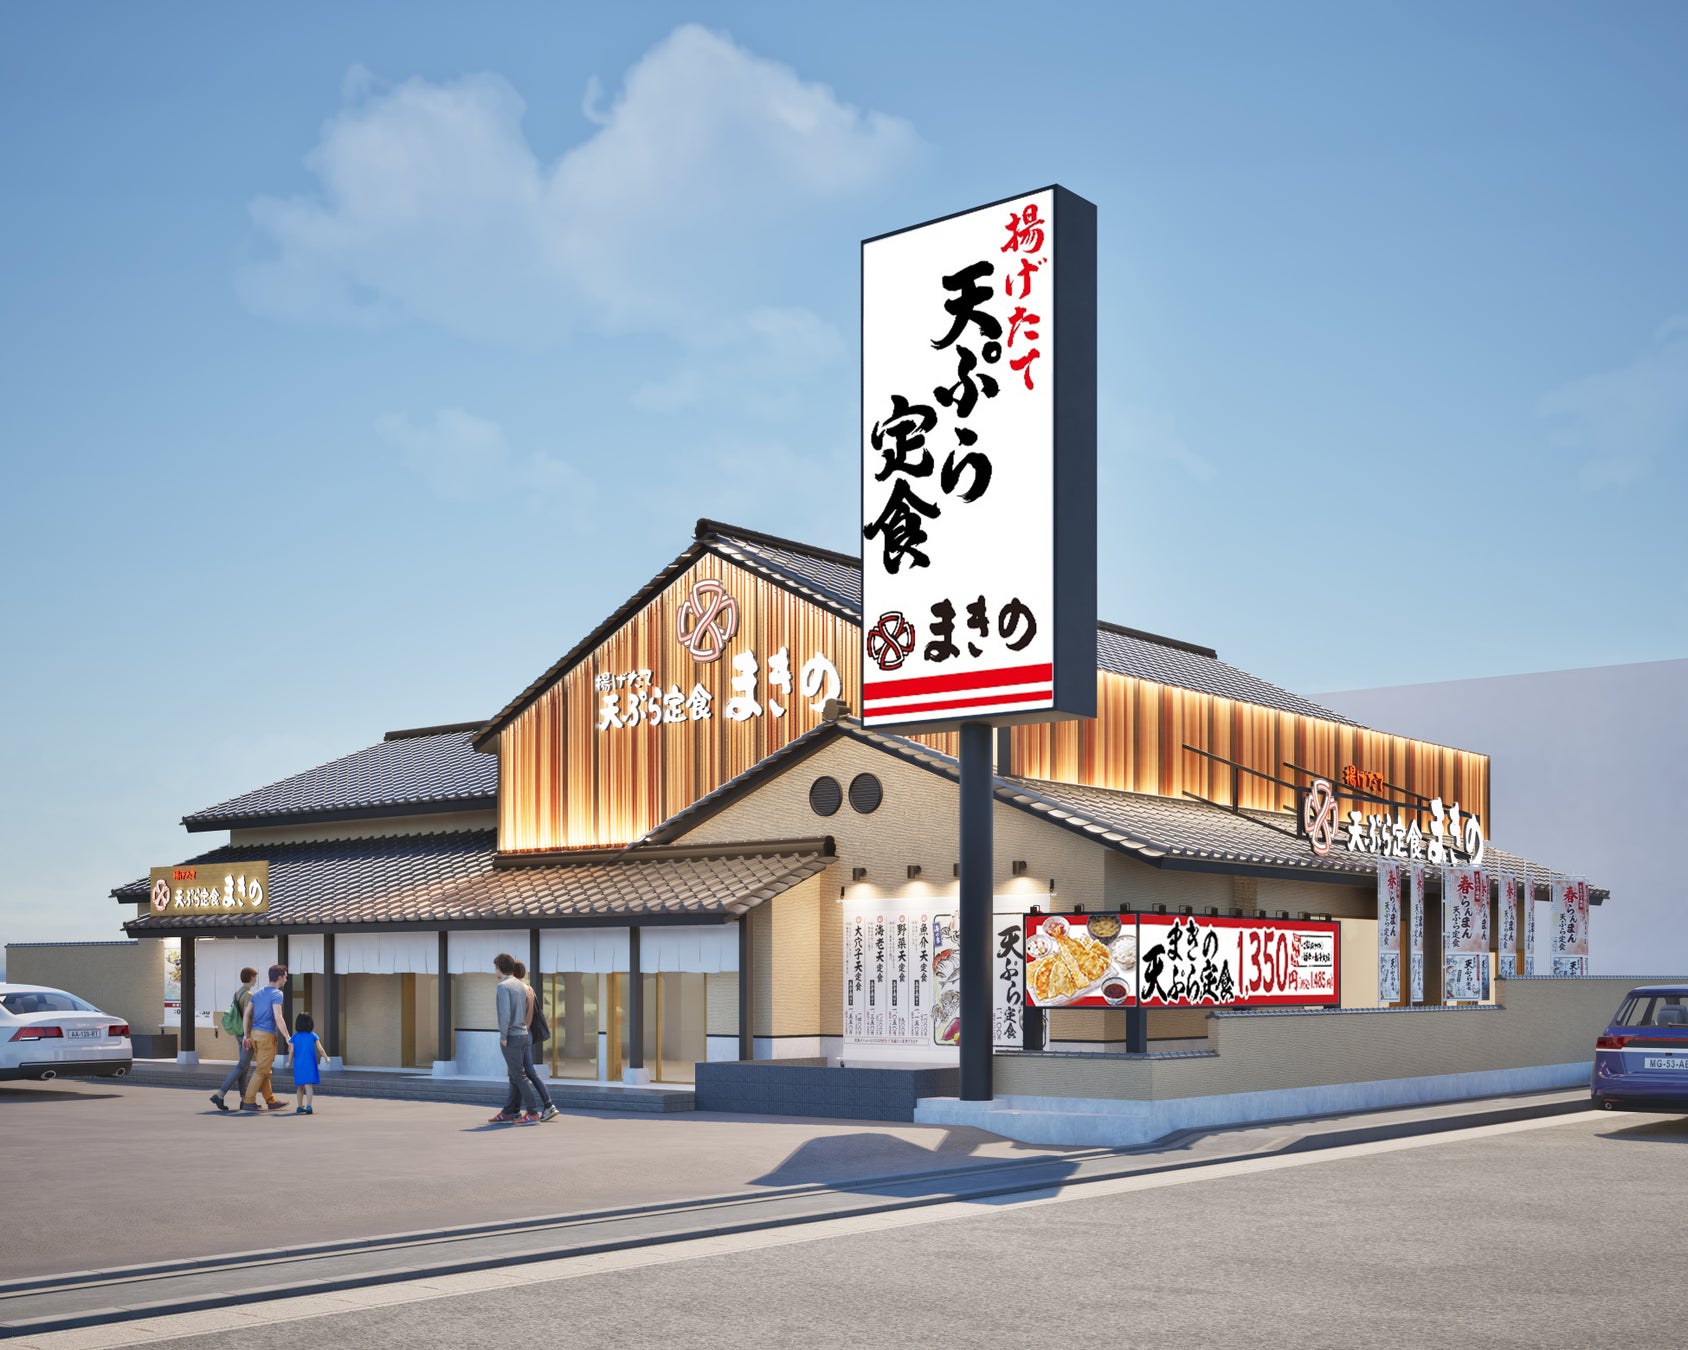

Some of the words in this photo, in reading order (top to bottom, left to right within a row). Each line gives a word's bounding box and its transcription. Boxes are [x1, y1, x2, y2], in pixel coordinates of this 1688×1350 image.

[1000, 203, 1048, 390] 揚げたて
[931, 260, 1003, 503] 天ぷら
[863, 395, 941, 574] 定食
[924, 595, 1037, 662] まきの
[595, 669, 653, 692] 揚げたて
[598, 683, 713, 730] 天ぷら定食
[725, 646, 841, 721] まきの
[1348, 810, 1422, 859] 天ぷら定食
[1428, 797, 1483, 864] まきの
[174, 887, 220, 908] 天ぷら定食
[222, 874, 263, 907] まきの
[1458, 874, 1474, 939] 春らんまん
[1564, 886, 1578, 943] 春らんまん
[1166, 920, 1219, 961] まきの
[1452, 905, 1461, 947] 天ぷら定食
[997, 925, 1023, 1039] 天ぷら定食
[1141, 944, 1236, 1001] 天ぷら定食
